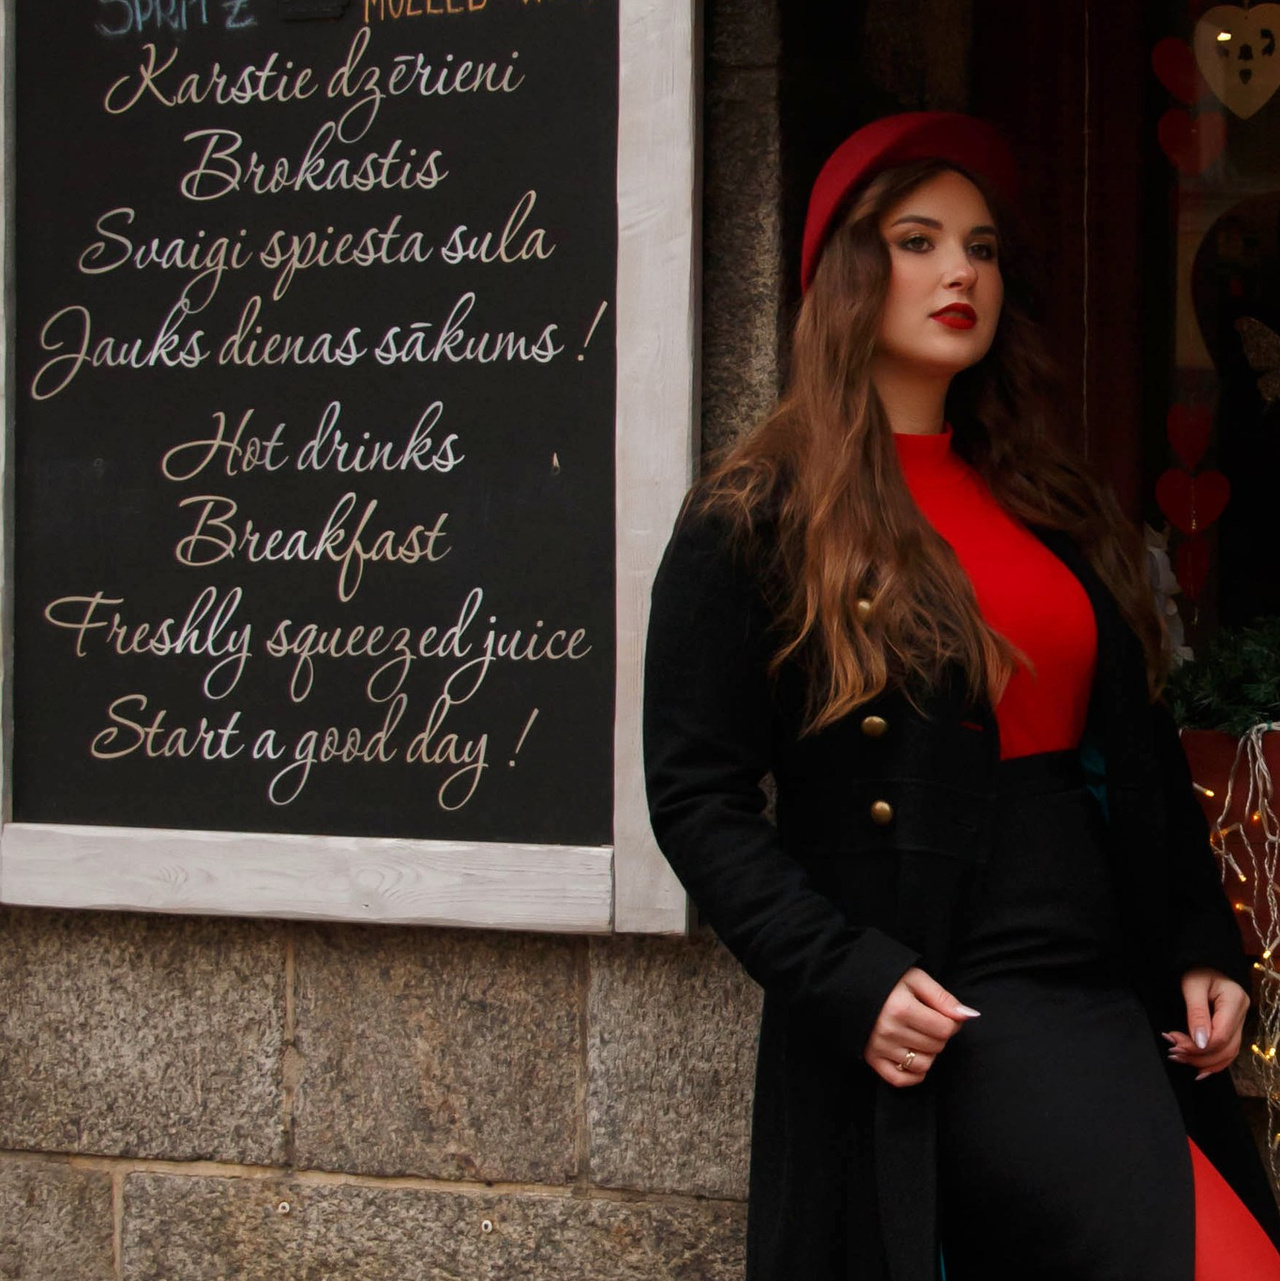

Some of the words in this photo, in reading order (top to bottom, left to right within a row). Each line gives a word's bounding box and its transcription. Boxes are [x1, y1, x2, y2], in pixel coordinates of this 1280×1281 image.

[104, 43, 318, 114] Karstie
[327, 26, 525, 144] dzērieni
[180, 121, 449, 201] Brokastis
[78, 207, 253, 313] Svaigi
[261, 215, 433, 300] spiesta
[441, 190, 557, 264] sula
[31, 297, 210, 401] Jauks
[218, 295, 367, 366] dienas
[374, 292, 564, 365] sākums
[162, 409, 289, 481] Hot
[297, 401, 465, 474] drinks
[175, 491, 452, 603] Breakfast
[44, 586, 253, 700] Freshly
[265, 587, 483, 703] squeezed
[444, 615, 593, 705] juice
[90, 694, 244, 761] Start
[252, 732, 286, 761] a
[268, 694, 408, 806] good
[406, 692, 489, 811] day
